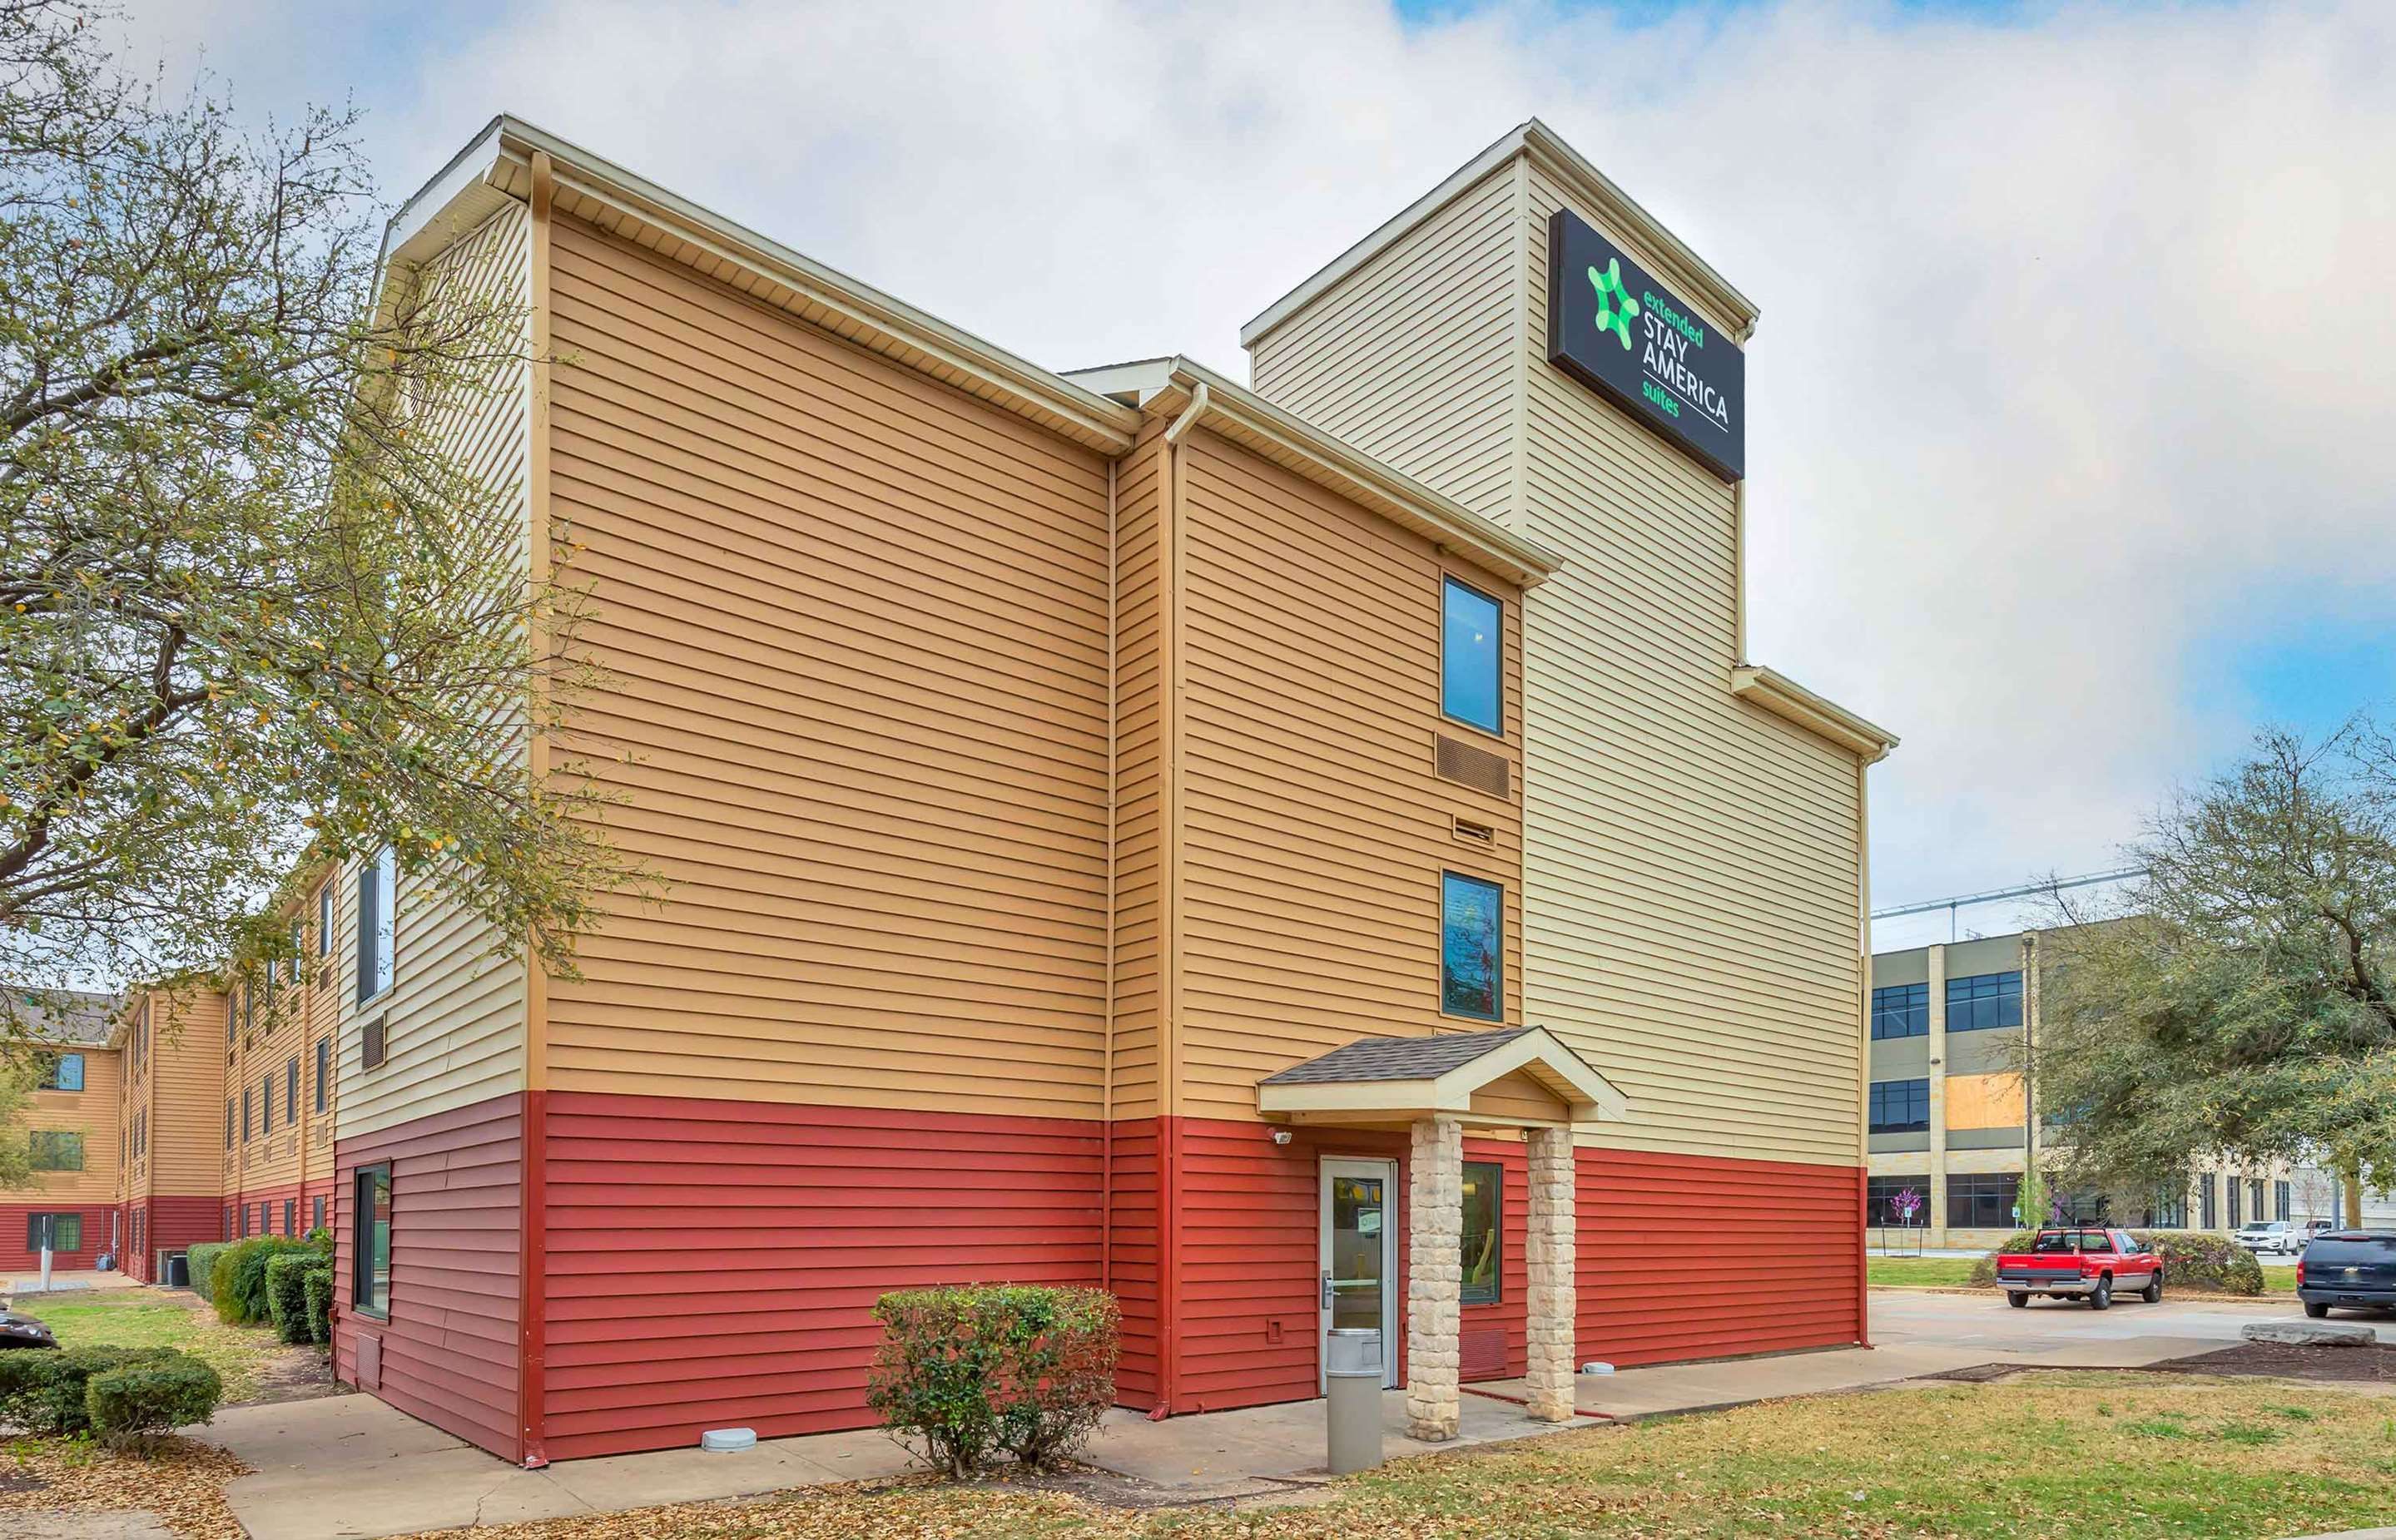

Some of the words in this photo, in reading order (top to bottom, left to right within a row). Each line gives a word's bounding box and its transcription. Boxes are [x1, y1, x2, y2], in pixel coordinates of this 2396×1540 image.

[1644, 291, 1704, 349] extended
[1644, 311, 1689, 363] STAY
[1643, 342, 1729, 424] AMERICA
[1643, 381, 1679, 418] suites
